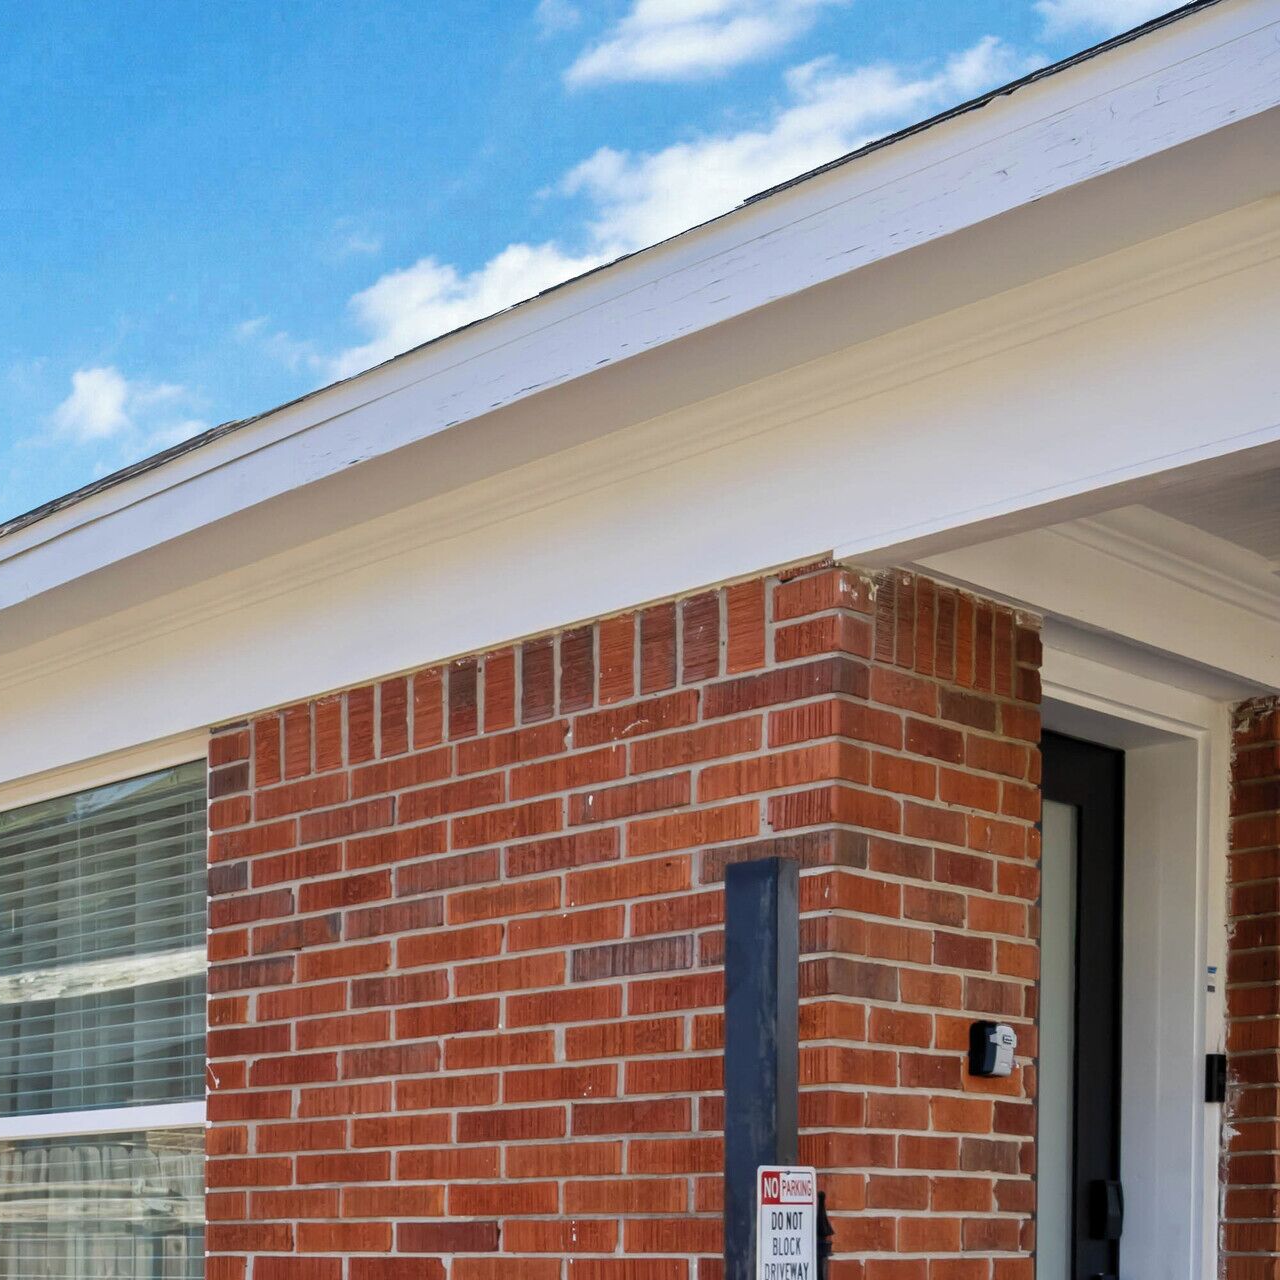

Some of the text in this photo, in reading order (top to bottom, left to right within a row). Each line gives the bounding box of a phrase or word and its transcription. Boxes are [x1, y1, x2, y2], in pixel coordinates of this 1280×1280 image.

[764, 1177, 811, 1198] NO PARKING
[771, 1211, 803, 1230] DO NOT
[773, 1237, 801, 1255] BLOCK
[765, 1263, 809, 1280] DRIVEWAY
